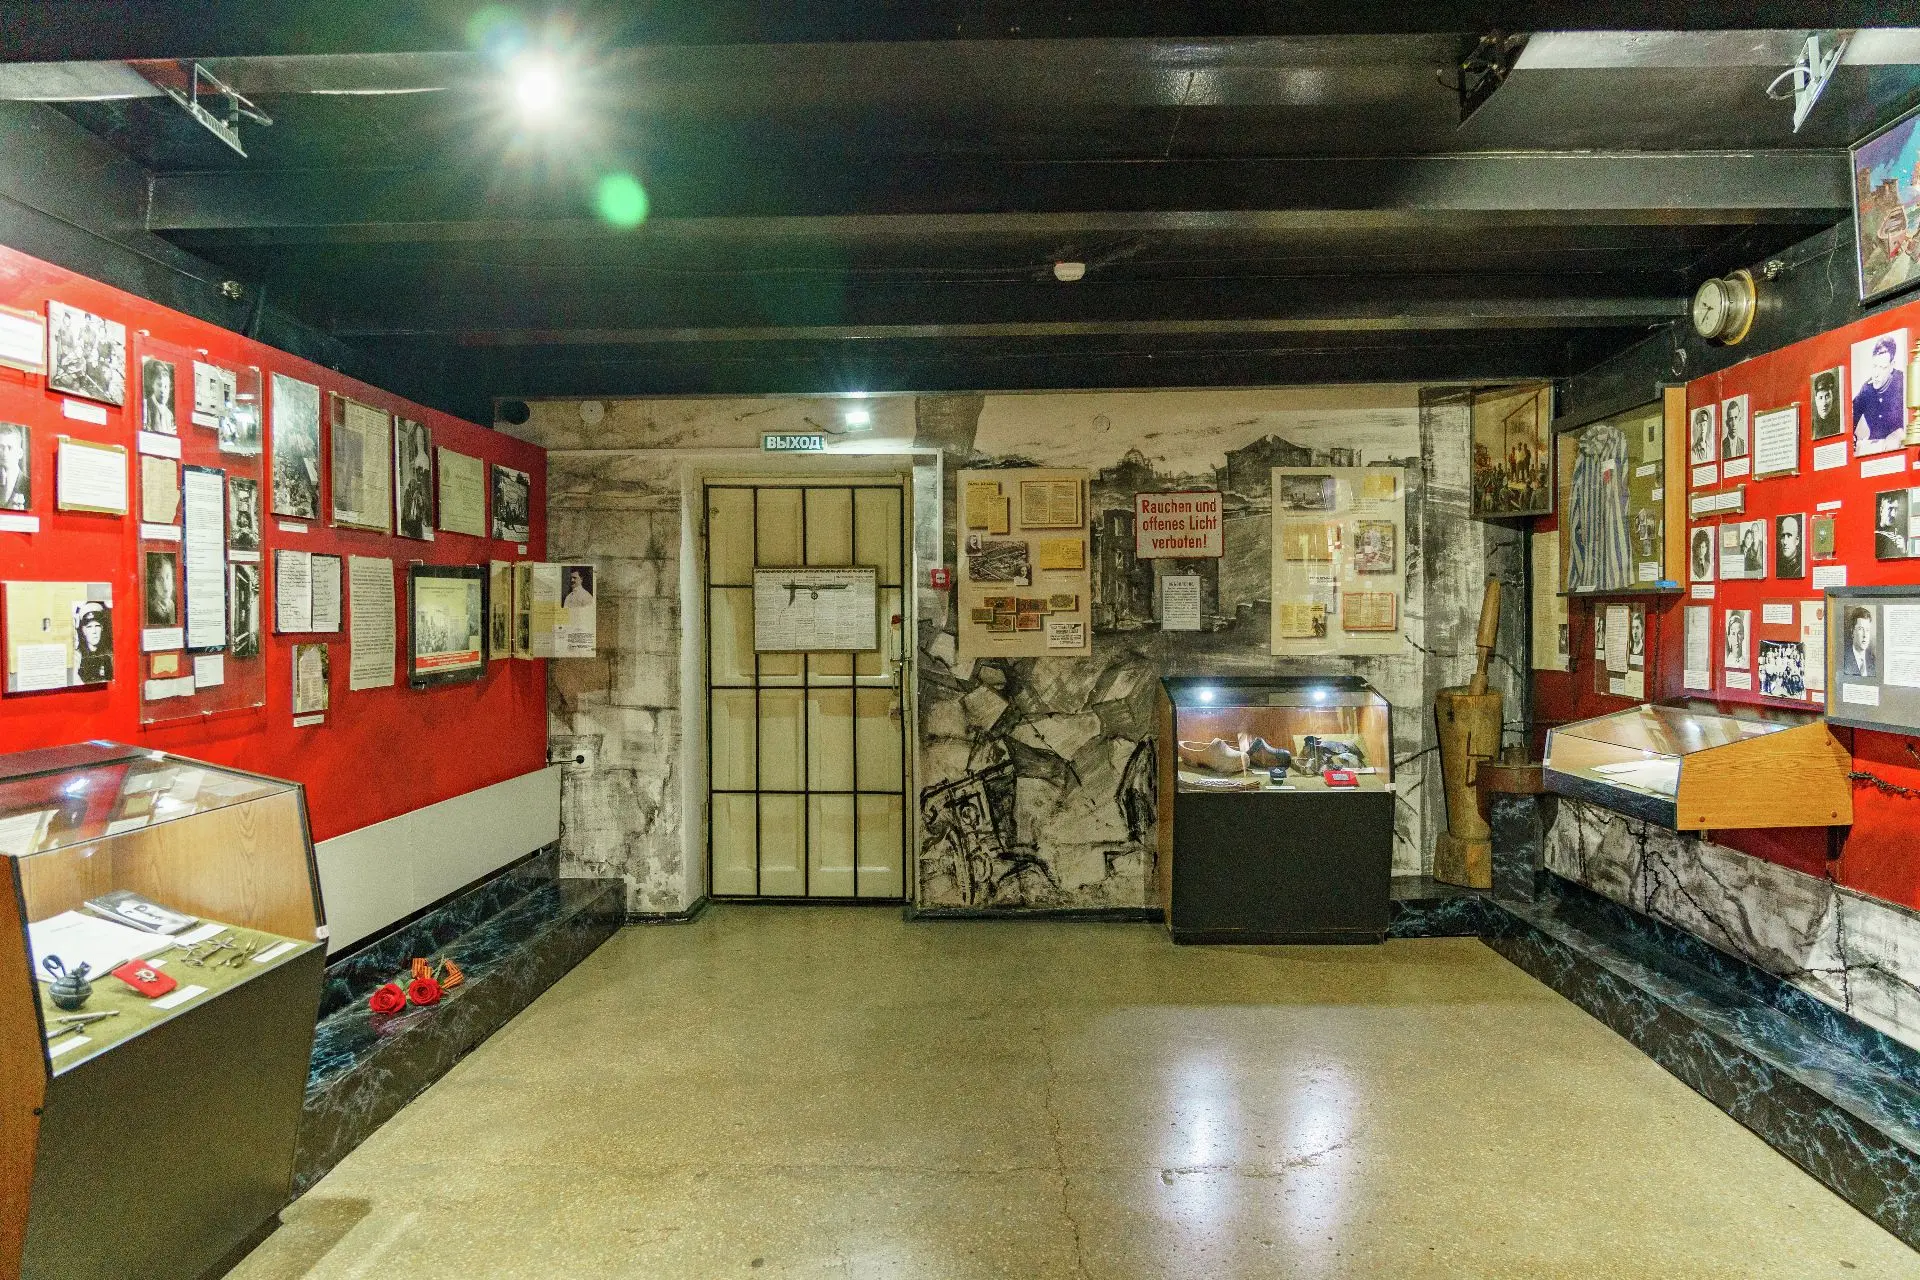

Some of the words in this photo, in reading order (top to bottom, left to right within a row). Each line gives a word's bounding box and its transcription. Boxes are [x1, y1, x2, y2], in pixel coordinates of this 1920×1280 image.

[766, 436, 821, 449] ВЫХОД
[1141, 499, 1192, 513] Rauchen
[1195, 498, 1217, 512] und
[1142, 516, 1185, 531] offenes
[1189, 515, 1217, 530] Licht
[1151, 534, 1207, 549] verboten!
